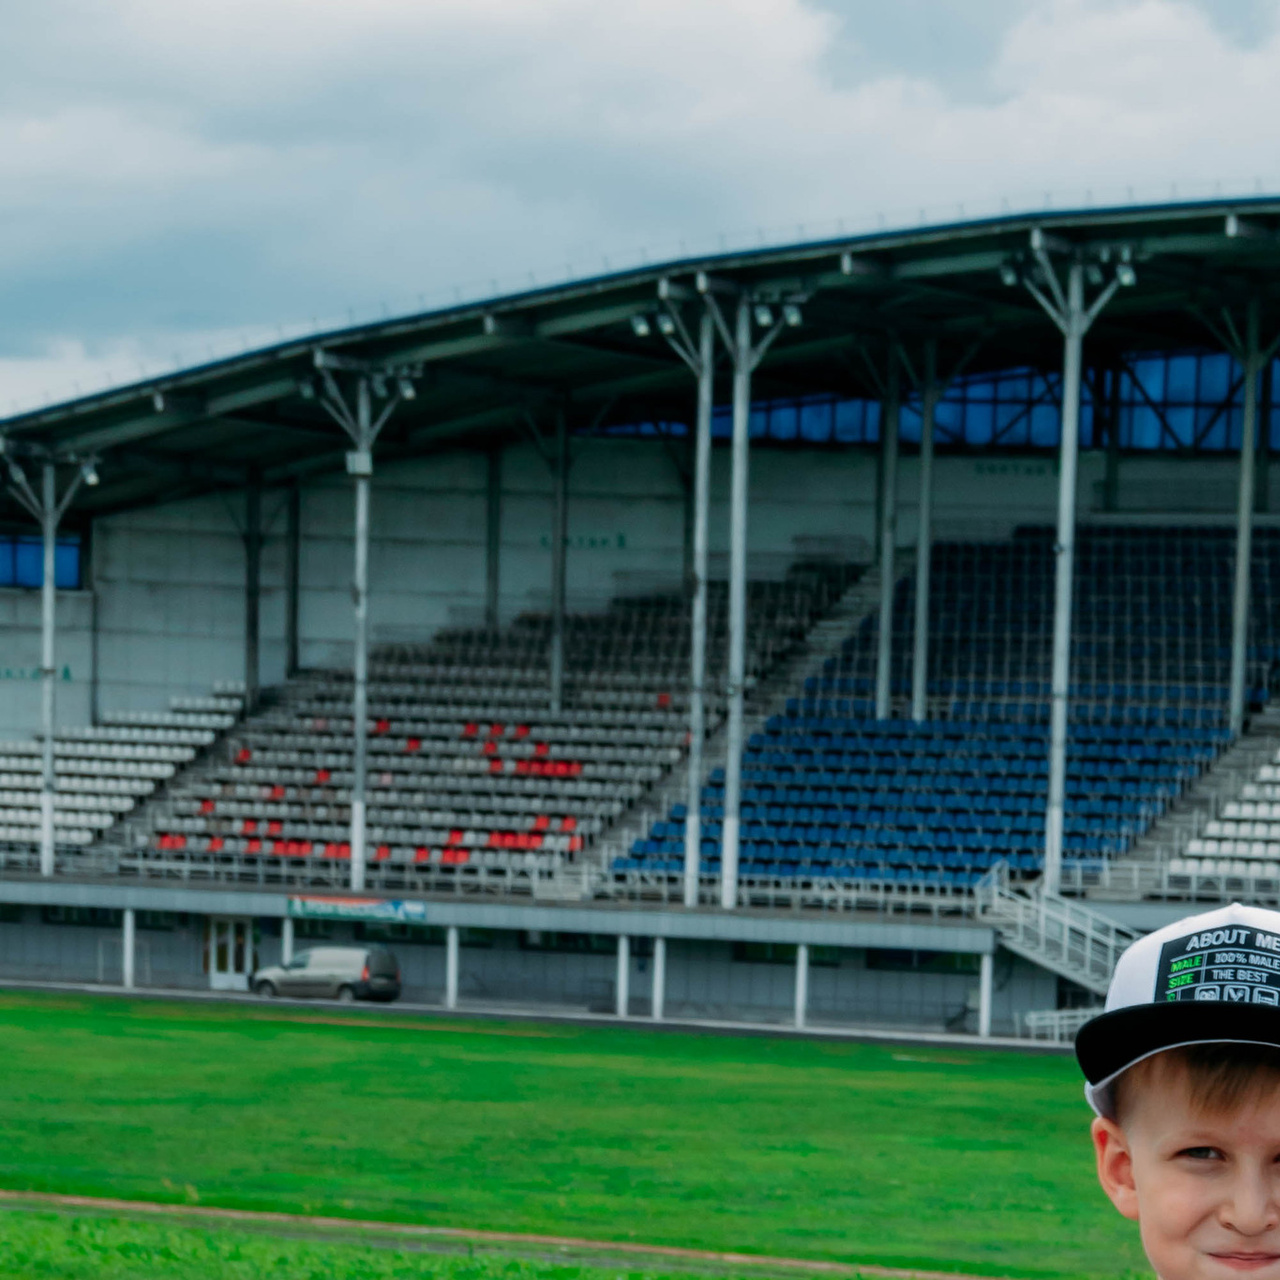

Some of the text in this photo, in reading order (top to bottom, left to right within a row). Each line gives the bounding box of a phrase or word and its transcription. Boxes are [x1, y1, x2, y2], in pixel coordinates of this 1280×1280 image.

[1186, 928, 1250, 951] ABOUT
[1170, 955, 1202, 972] MALE
[1214, 952, 1280, 970] 100% MALE
[1168, 973, 1194, 989] SIZE
[1211, 969, 1269, 983] THE BEST
